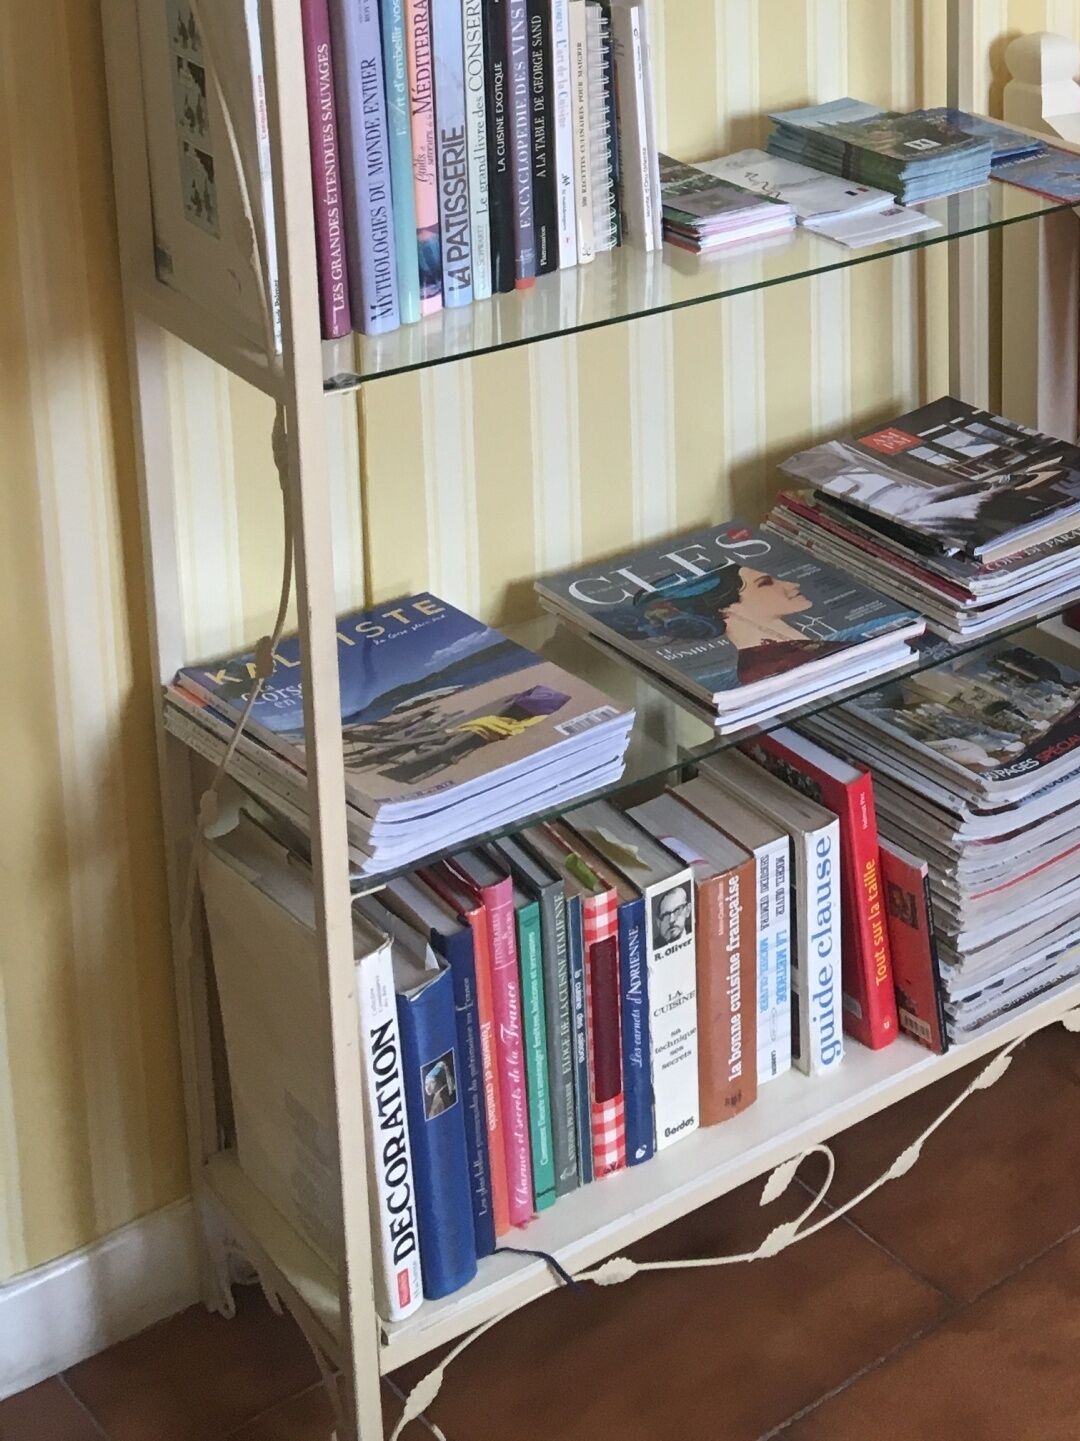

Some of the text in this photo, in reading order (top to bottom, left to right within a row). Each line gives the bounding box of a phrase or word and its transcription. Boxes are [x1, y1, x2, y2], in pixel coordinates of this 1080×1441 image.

[510, 5, 525, 55] VINS
[531, 14, 542, 46] SAND
[390, 26, 404, 93] d'embellir
[513, 59, 527, 91] DES
[532, 49, 543, 93] GEORGE
[556, 38, 569, 128] L'art de la Cuisine
[470, 95, 483, 111] des
[493, 61, 505, 172] LA CUISINE EXOTIQUE
[534, 95, 544, 111] DE
[471, 111, 485, 152] livre
[534, 113, 545, 152] TABLE
[578, 104, 586, 153] CULINAIRES
[317, 42, 345, 311] LES GRANDES ÉTENDUES SAUVAGES
[473, 152, 488, 194] grand
[536, 152, 546, 168] LA
[360, 56, 395, 321] MYTHOLOGIES DU MONDE ENTIER
[441, 124, 469, 263] PATISSERIE
[474, 194, 487, 214] Le
[538, 225, 547, 266] Flammarion
[985, 551, 1025, 573] COIN
[663, 638, 732, 662] BONHEUR
[995, 758, 1040, 778] PAGES
[775, 855, 785, 916] MICHEL OLIVER
[552, 892, 566, 954] ITALIENNE
[724, 874, 743, 951] française
[862, 858, 888, 986] Tout sur la taille
[654, 937, 694, 963] R. Oliver
[774, 930, 786, 947] LA
[809, 834, 841, 1067] guide clause
[529, 968, 539, 978] et
[556, 954, 568, 1000] CUISINE
[574, 969, 582, 979] la
[726, 951, 740, 1013] cuisine
[759, 937, 768, 1013] MICHEL OLIVER
[529, 979, 541, 1011] balcons
[574, 981, 583, 1010] cuisine
[624, 924, 643, 1069] Les carnets d'ADRIENNE
[653, 990, 696, 1018] CUISINE
[667, 990, 684, 1003] LA
[560, 1015, 570, 1034] DE
[654, 1026, 698, 1055] technique
[669, 1027, 682, 1038] sa
[727, 1012, 741, 1062] bonne
[533, 1047, 546, 1089] aménager
[661, 1048, 693, 1071] secrets
[669, 1044, 685, 1058] ses
[480, 1021, 498, 1131] Poissons et crustacés
[728, 1061, 741, 1081] la
[496, 980, 529, 1207] Charmes et secrets de la France
[536, 1088, 546, 1097] et
[536, 1098, 547, 1126] fleurir
[368, 1017, 417, 1265] DECORATION
[538, 1126, 550, 1165] Comment
[663, 1117, 696, 1139] Bordas
